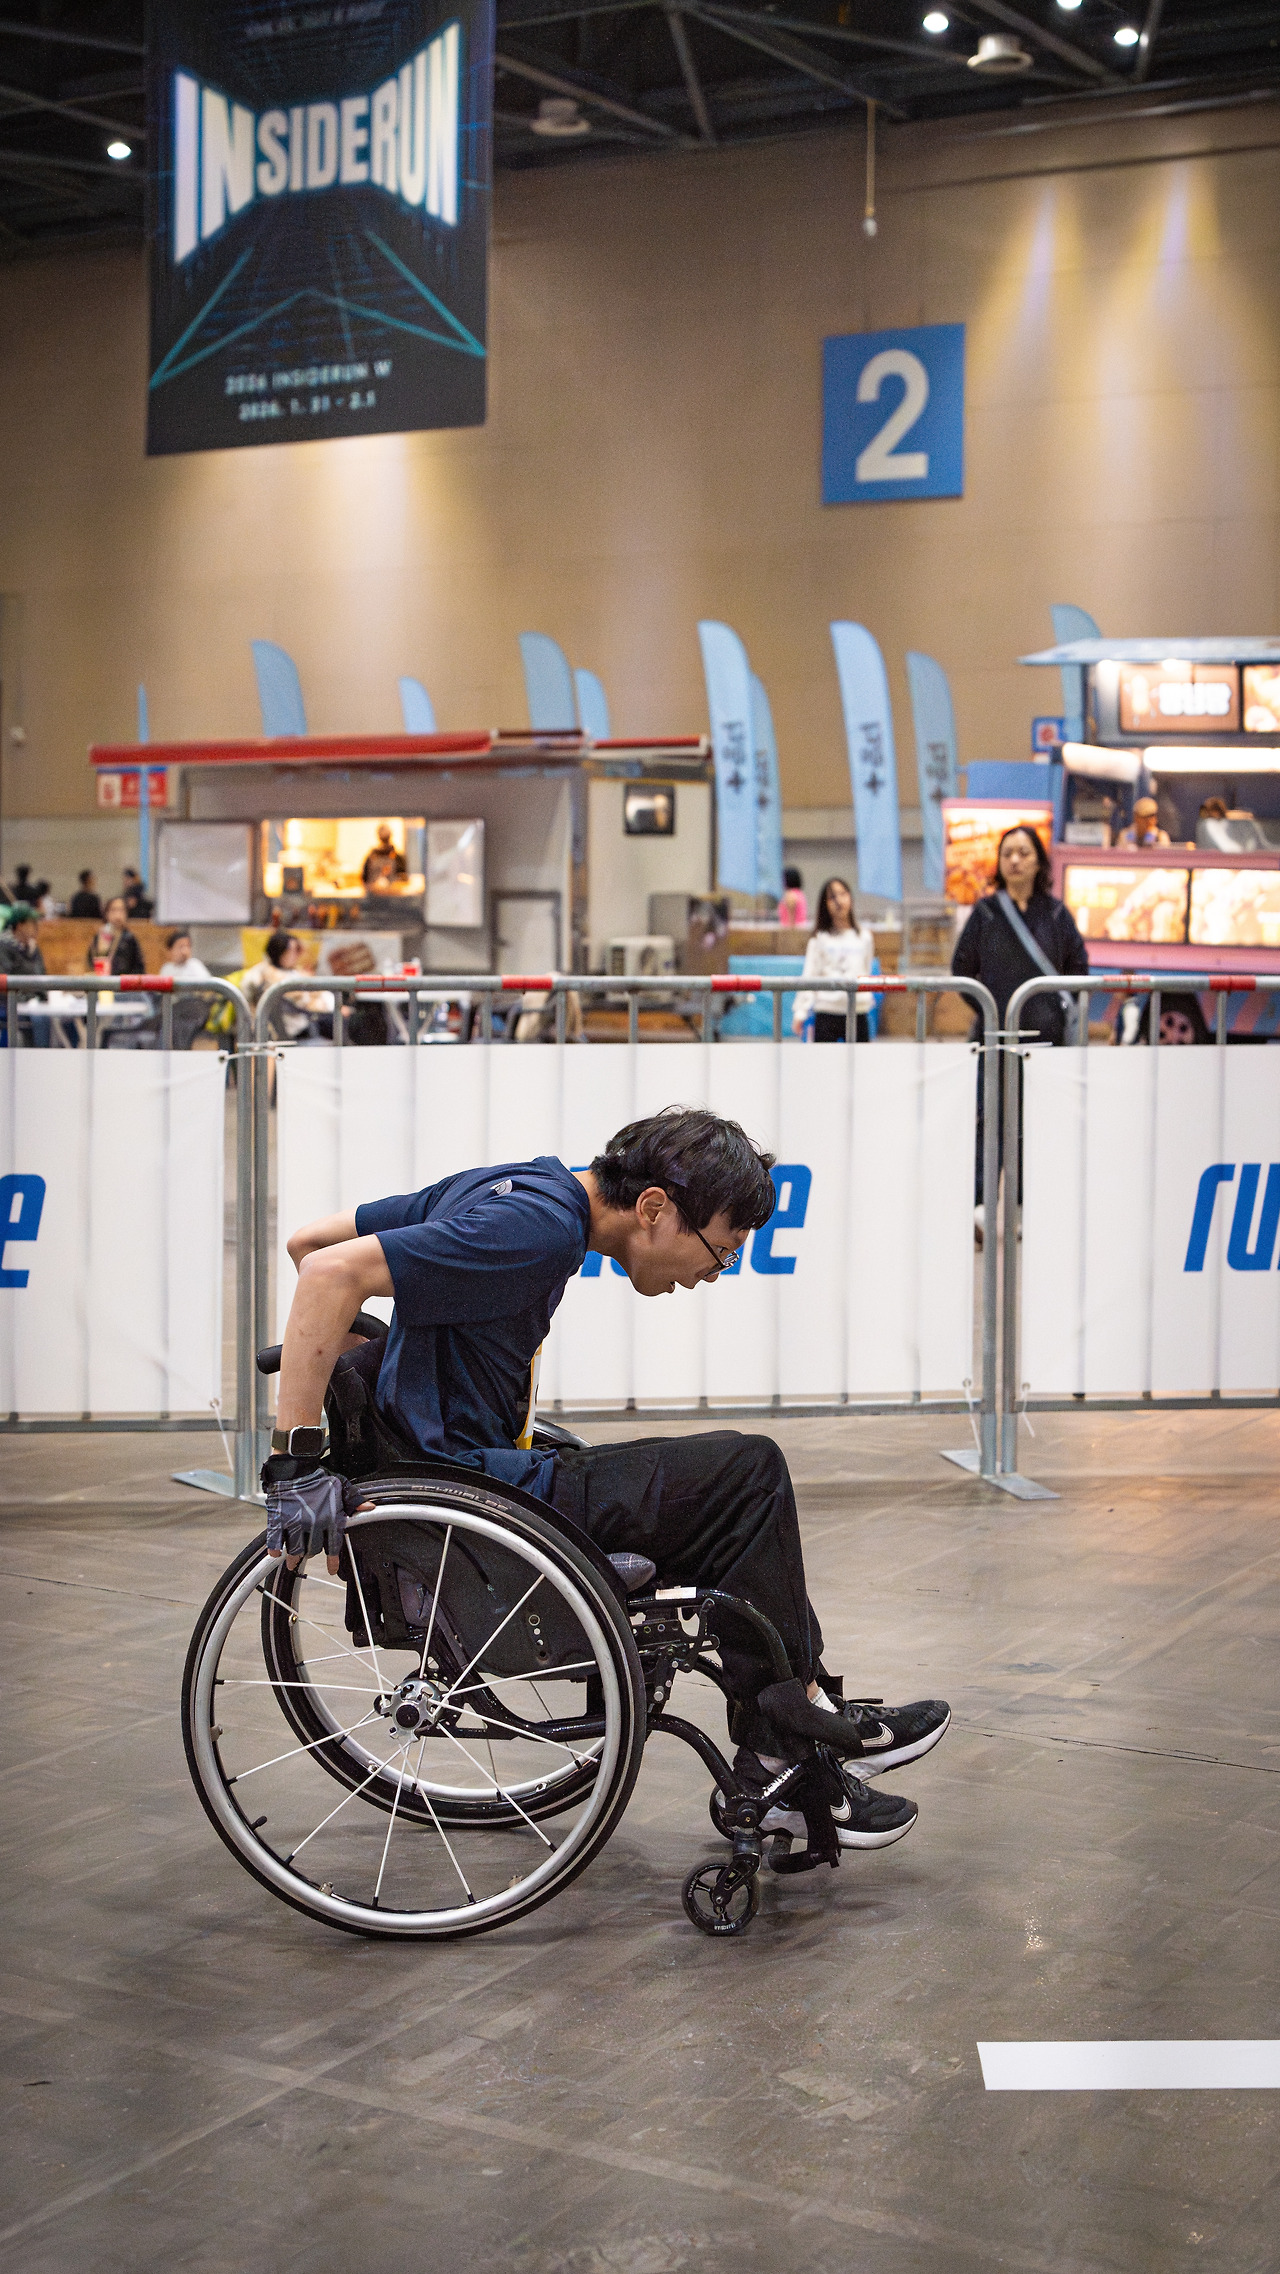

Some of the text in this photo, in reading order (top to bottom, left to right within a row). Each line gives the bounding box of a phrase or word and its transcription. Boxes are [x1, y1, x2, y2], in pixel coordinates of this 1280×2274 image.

[175, 23, 459, 265] INSIDERUN
[272, 362, 369, 389] INSIDERUN
[856, 348, 929, 482] 2
